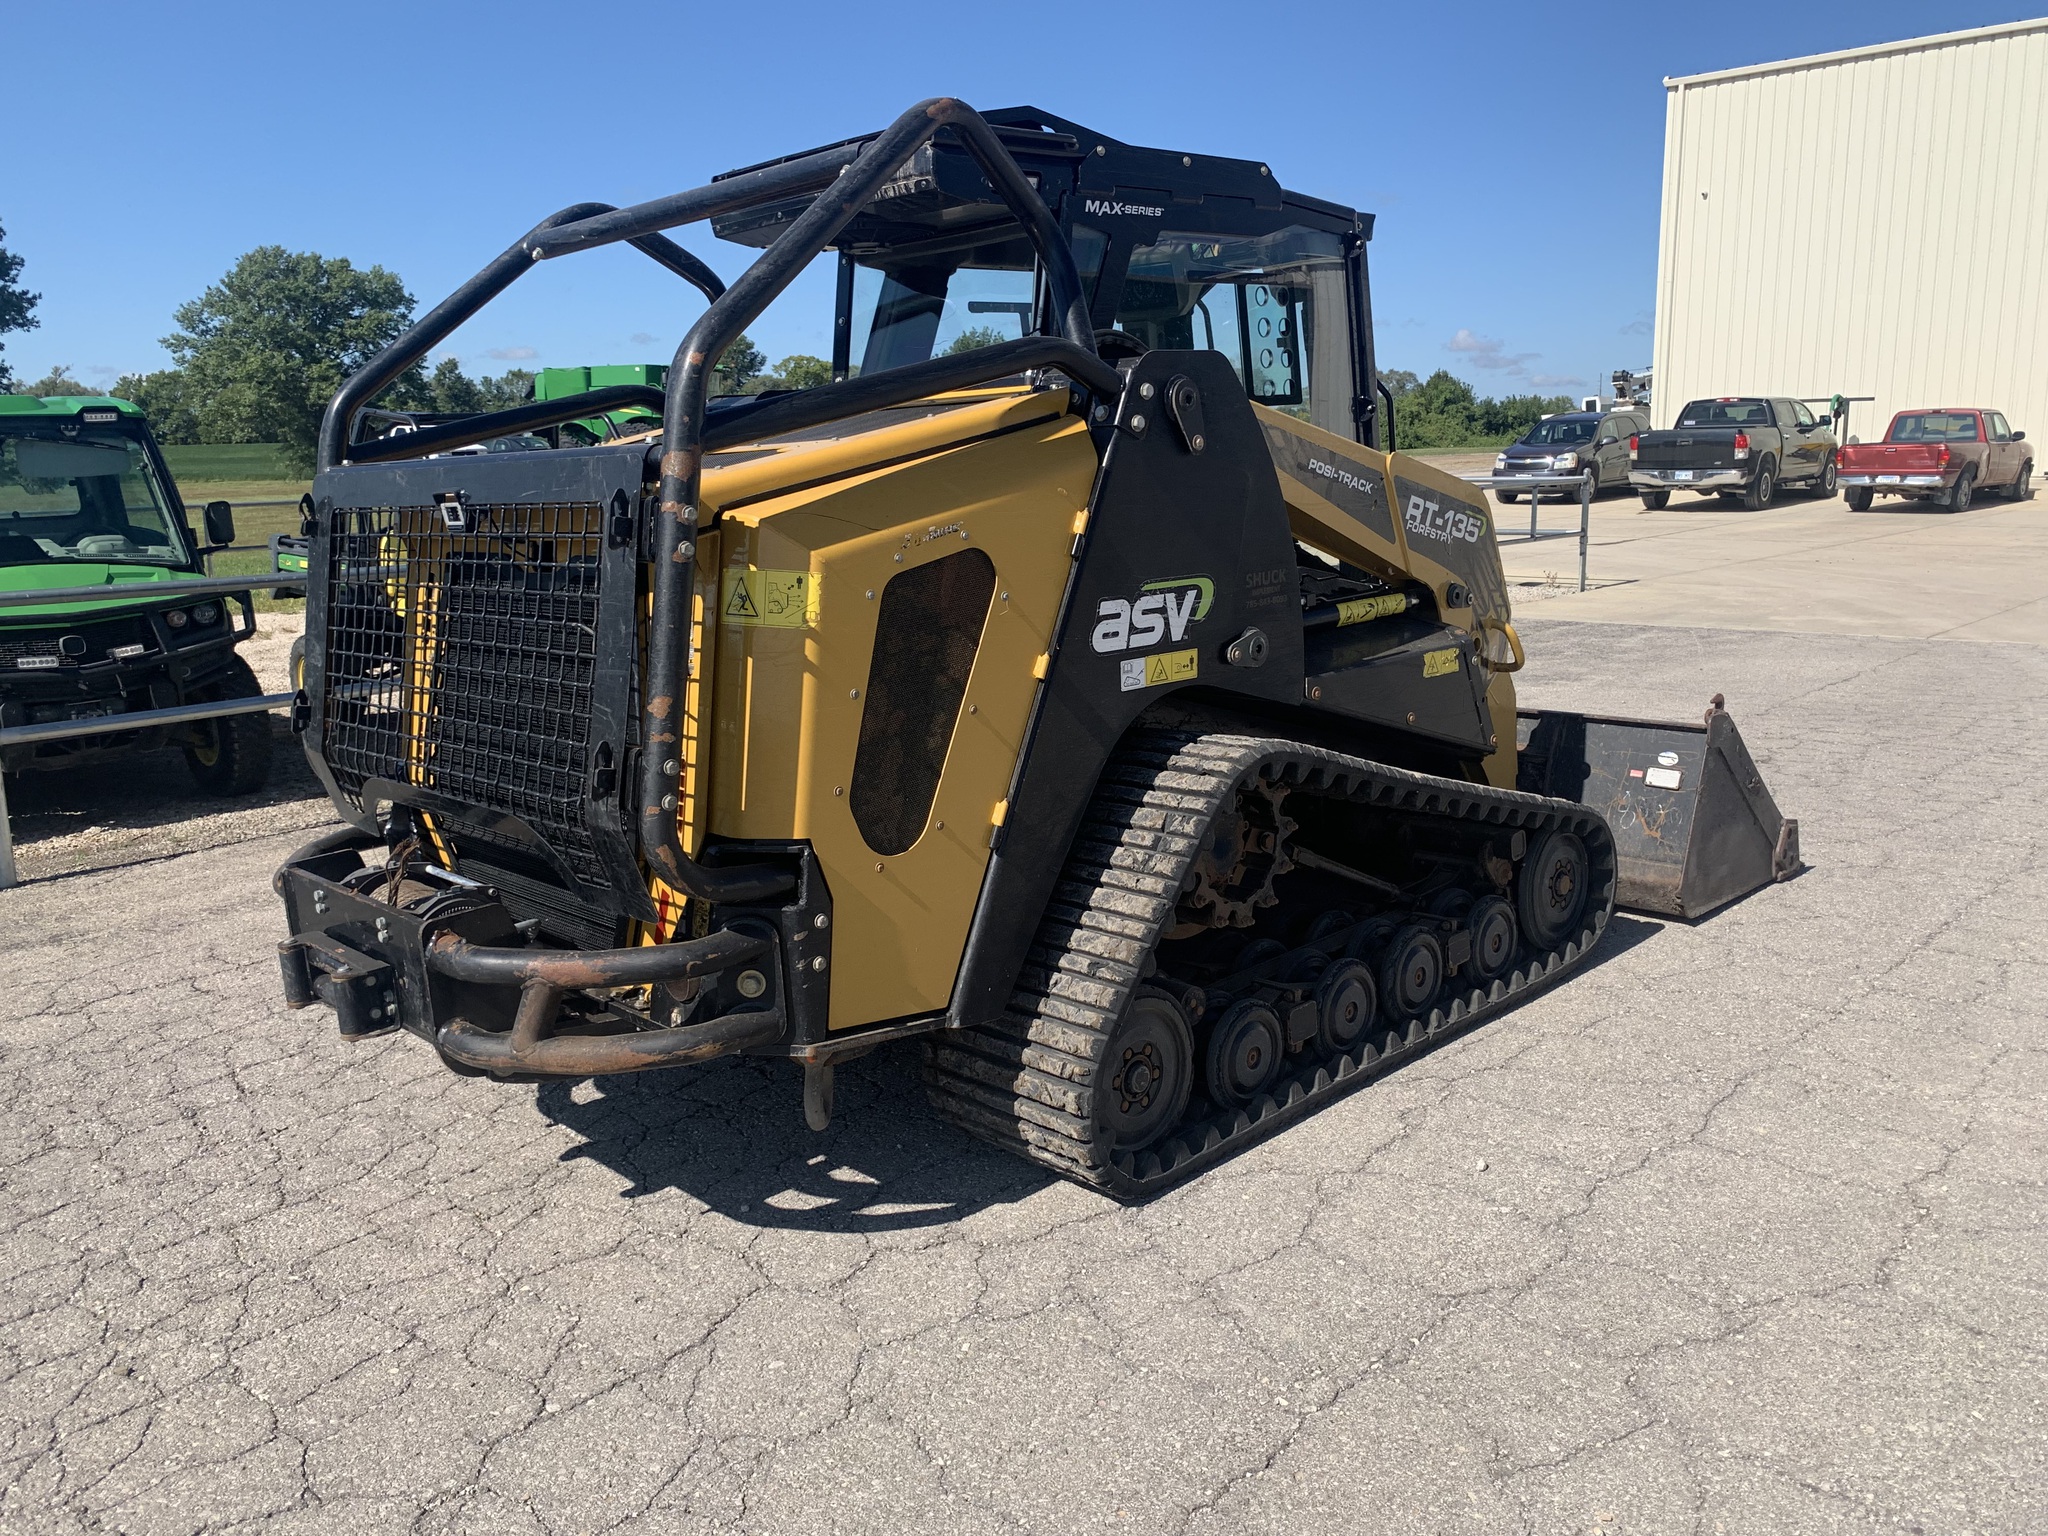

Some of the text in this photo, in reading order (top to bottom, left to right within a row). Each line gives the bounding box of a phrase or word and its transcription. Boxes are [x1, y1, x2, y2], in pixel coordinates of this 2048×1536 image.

[1085, 200, 1162, 217] MAX-SERIES
[1308, 458, 1374, 495] POSI-TRACK
[1405, 495, 1481, 543] RT-135
[1406, 520, 1453, 544] FORESTRY
[1246, 568, 1287, 588] SHUCK
